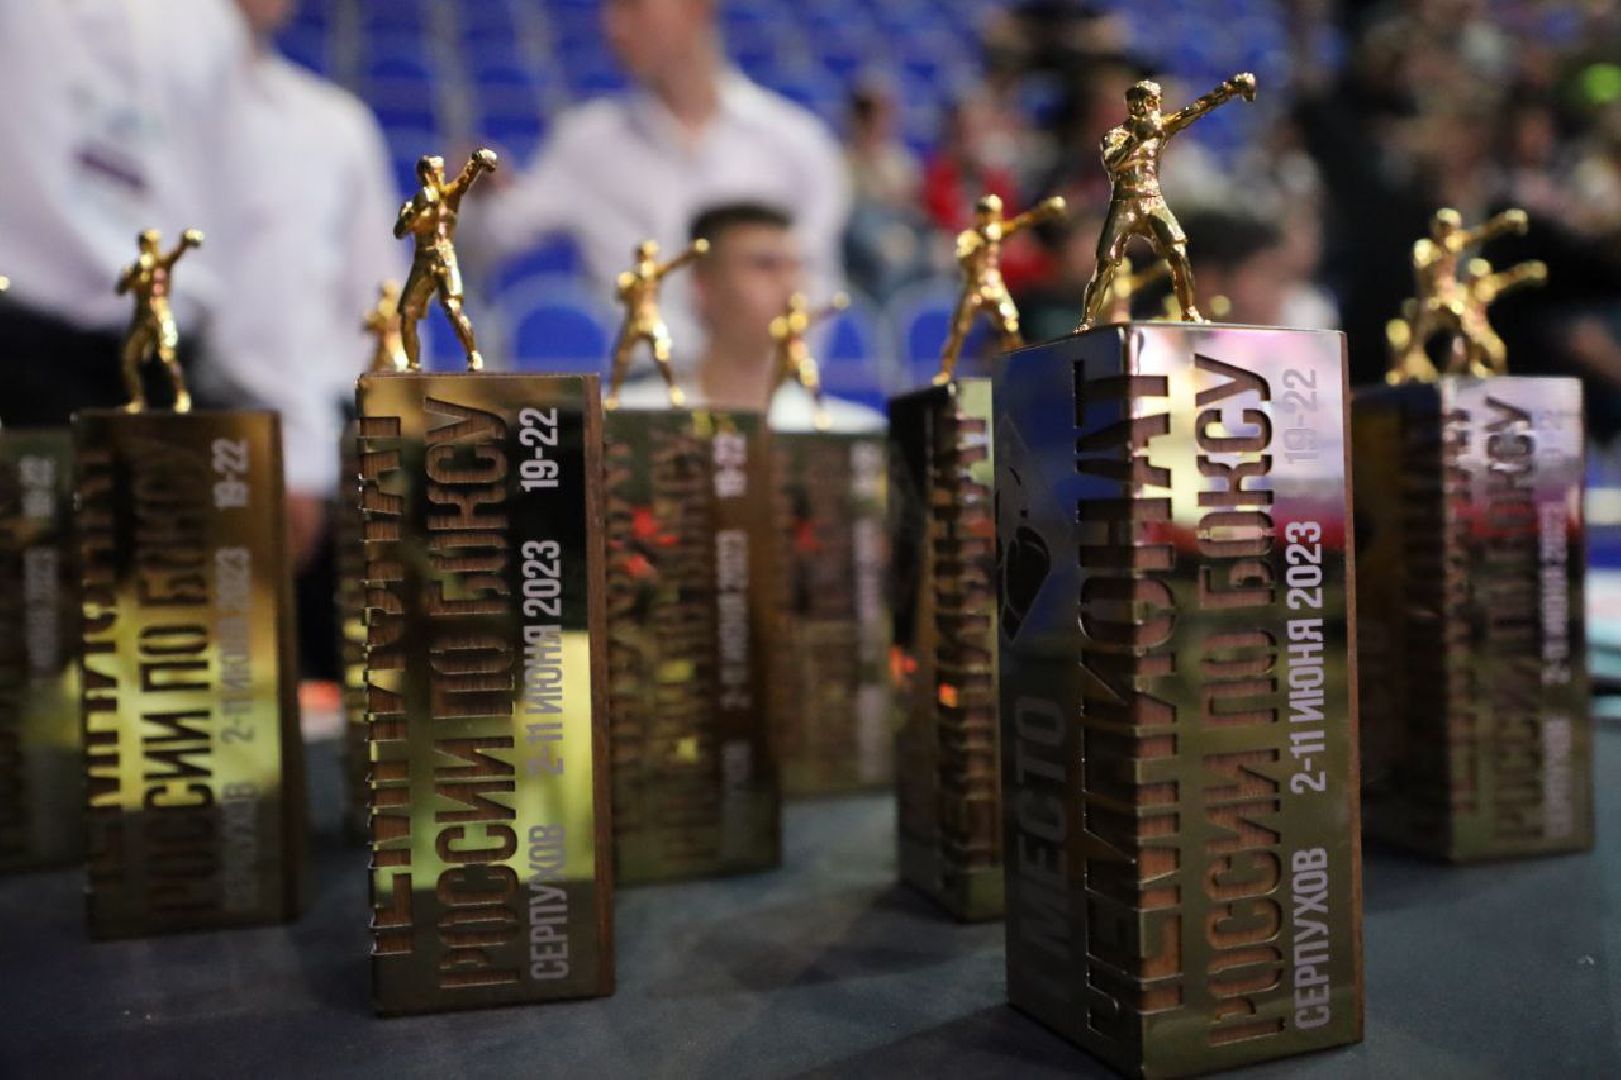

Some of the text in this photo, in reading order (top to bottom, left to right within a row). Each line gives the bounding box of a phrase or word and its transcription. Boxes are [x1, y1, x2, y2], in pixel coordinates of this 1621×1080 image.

[139, 623, 211, 693] ПО
[425, 397, 520, 988] РОССИИ ПО БОКСУ
[518, 407, 568, 980] СЕРПУХОВ 2-11 ИЮНЯ 2023 19-22
[1013, 696, 1070, 958] МЕСТО
[1073, 359, 1184, 1036] ЧЕМПИОНАТ
[1195, 353, 1286, 1048] РОССИИ ПО БОКСУ
[1281, 367, 1330, 1031] СЕРПУХОВ 2-11 ИЮНЯ 2023 19-22
